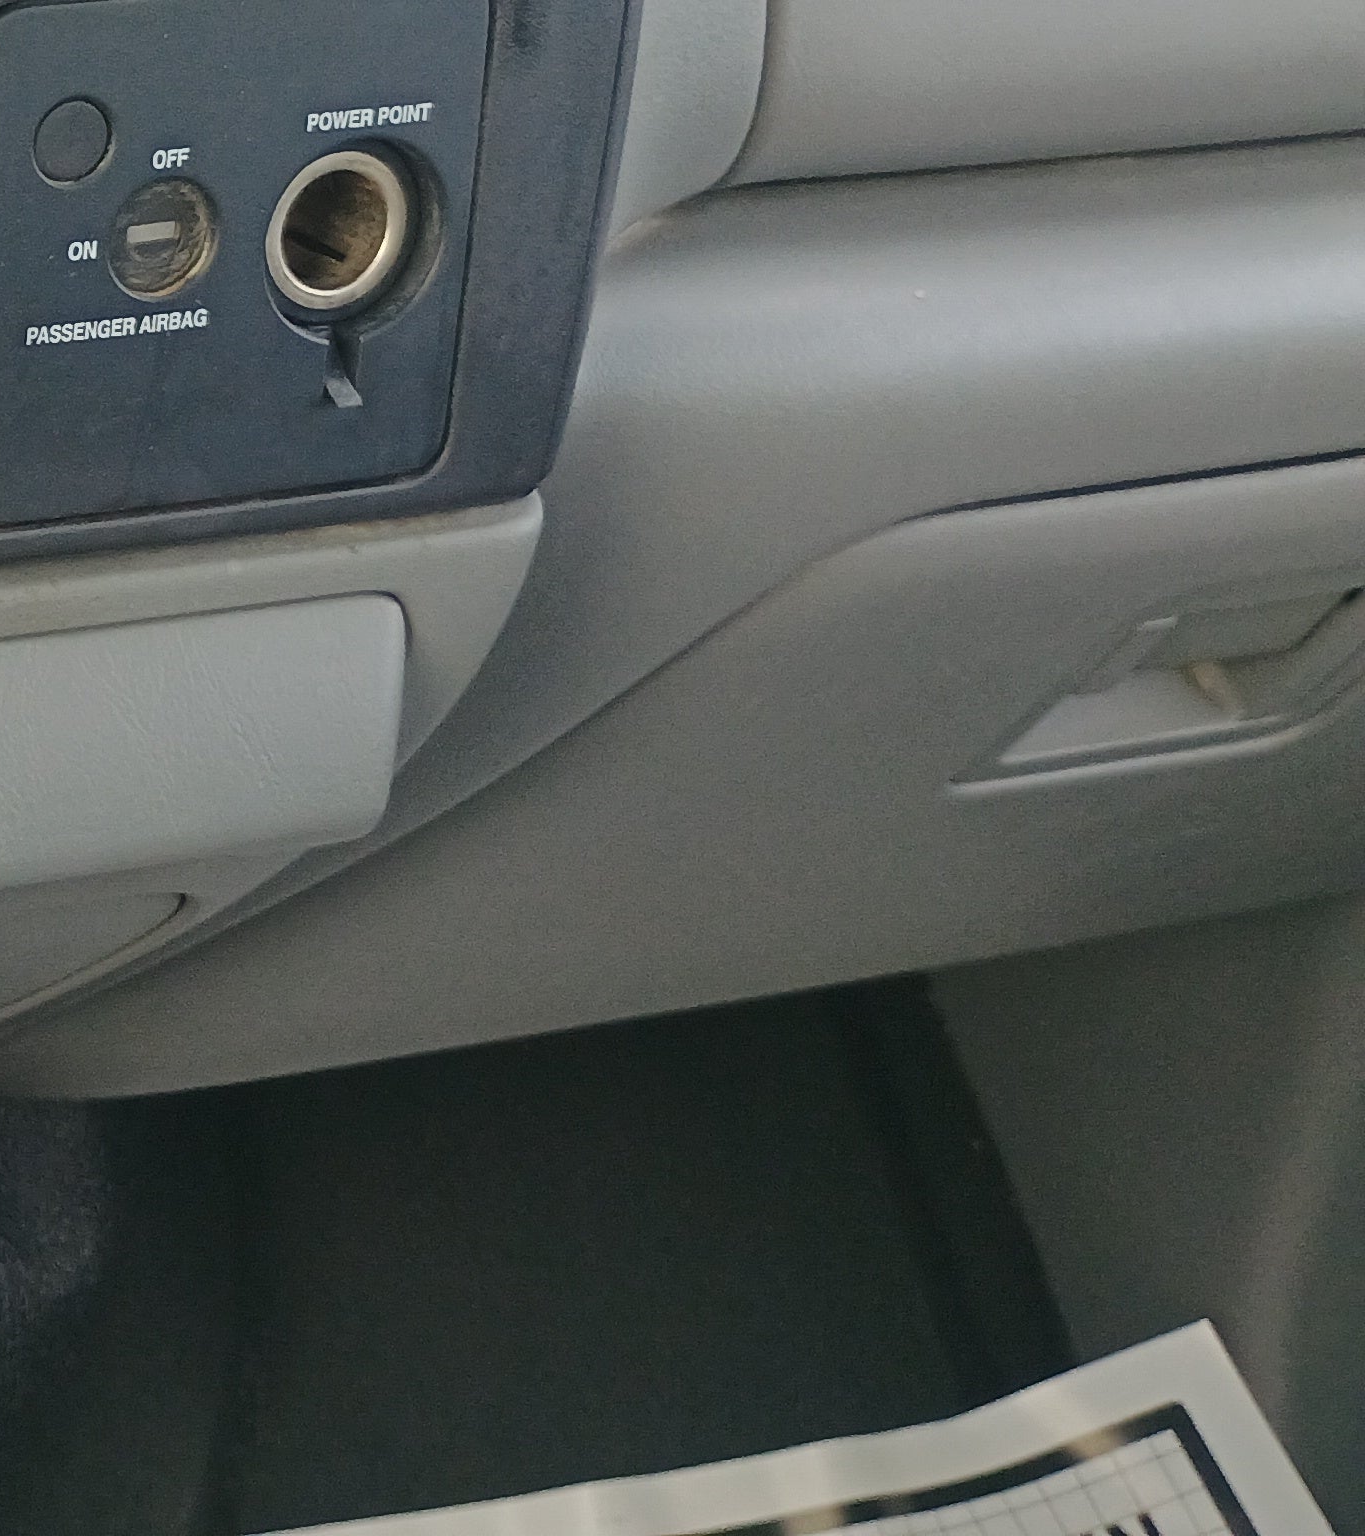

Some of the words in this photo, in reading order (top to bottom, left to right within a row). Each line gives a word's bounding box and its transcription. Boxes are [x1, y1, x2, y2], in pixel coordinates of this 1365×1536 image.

[306, 107, 375, 133] POWER
[377, 102, 435, 126] POINT
[152, 147, 190, 170] OFF
[67, 240, 98, 261] ON
[25, 316, 135, 346] PASSENGER
[139, 308, 208, 335] AIRBAG
